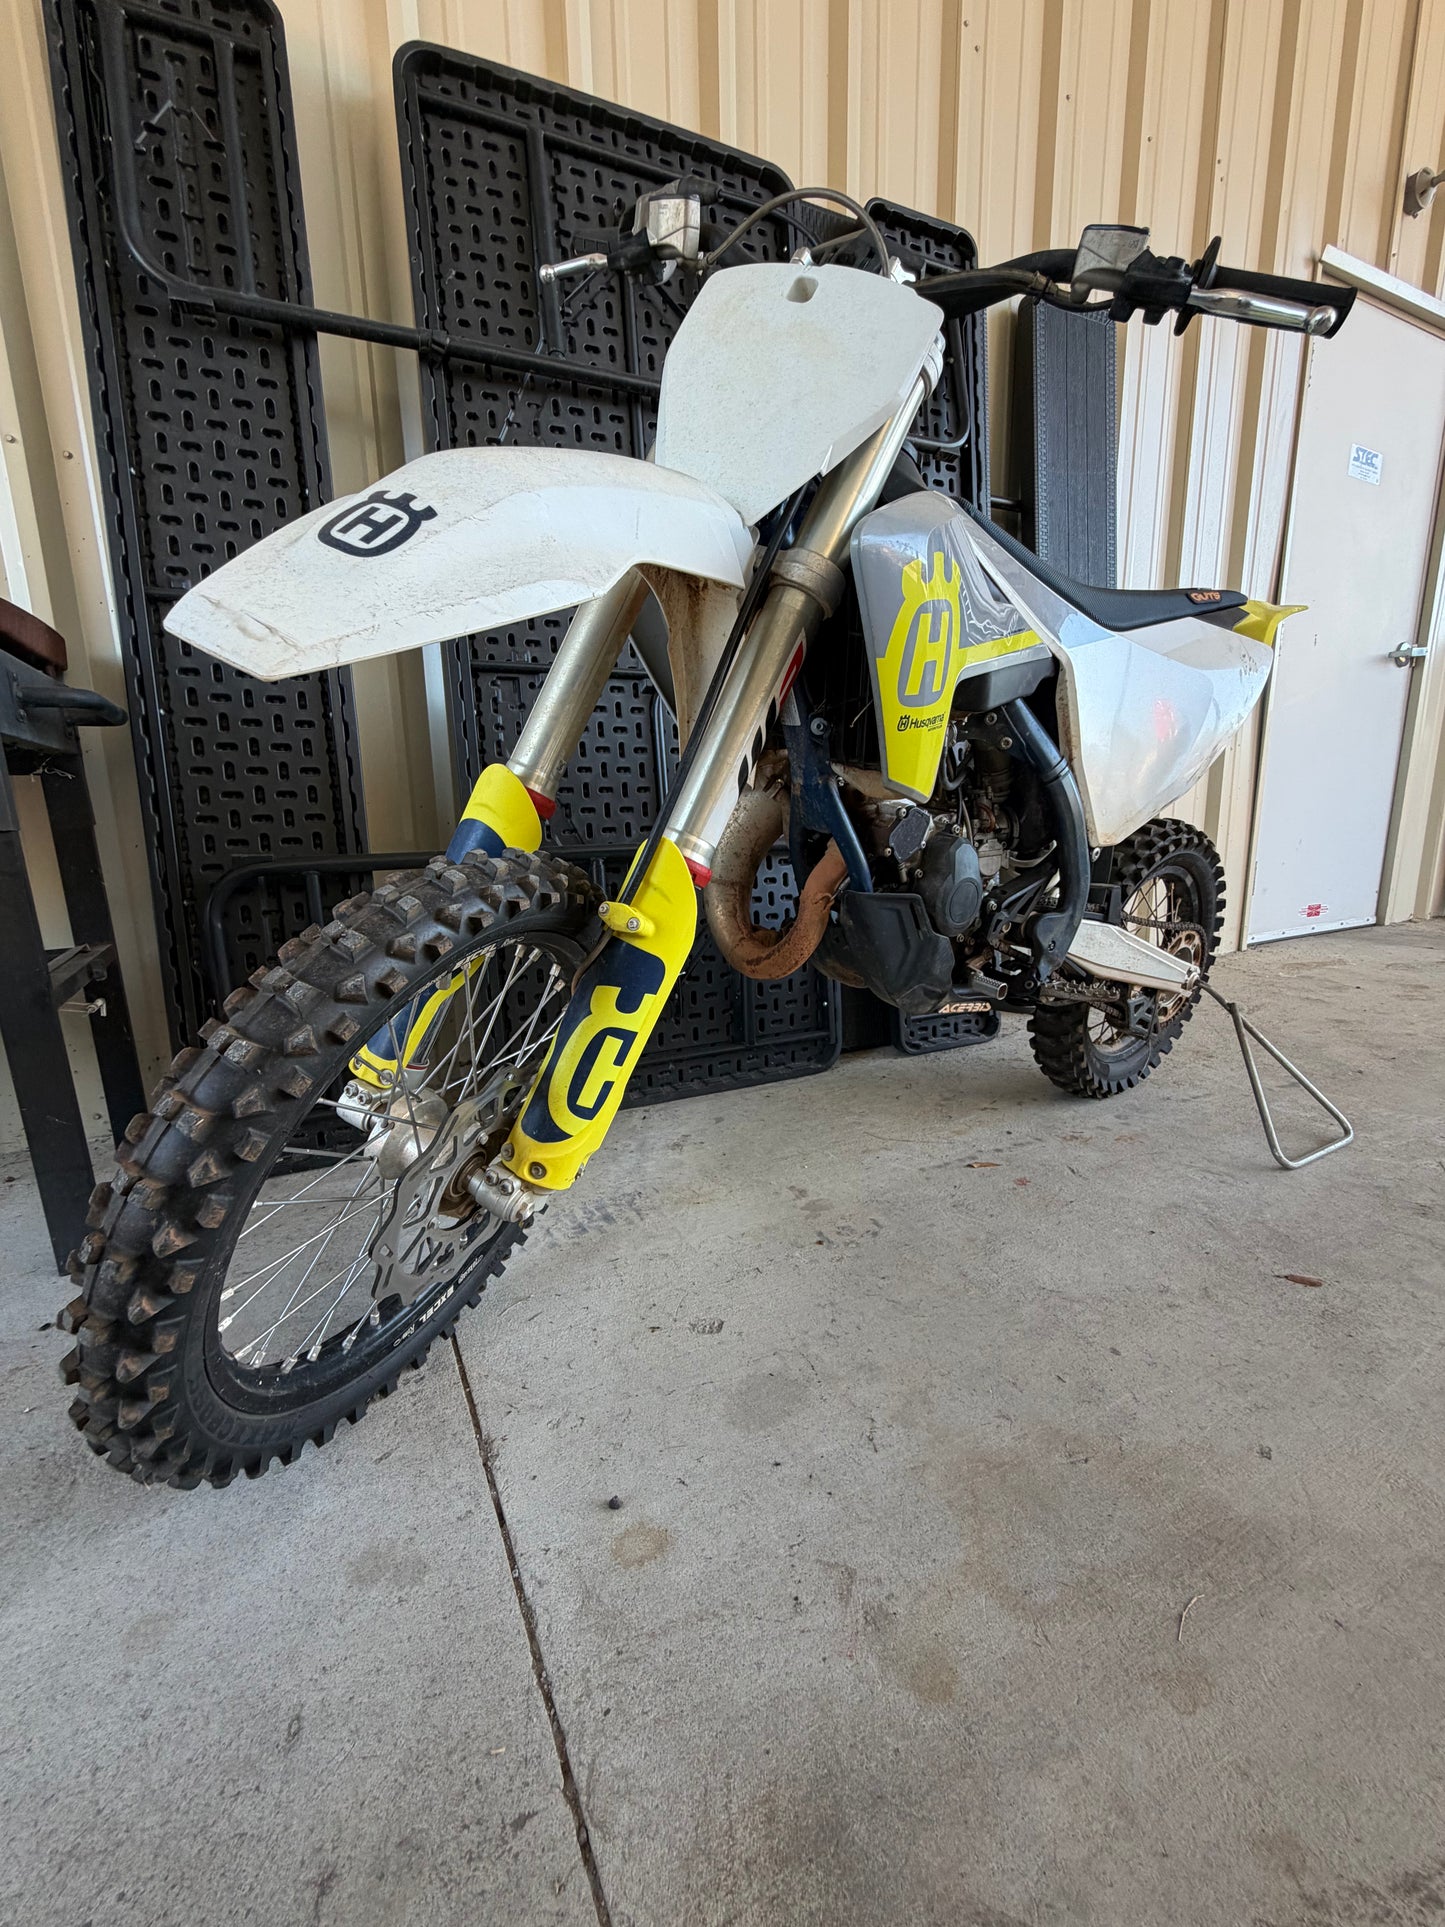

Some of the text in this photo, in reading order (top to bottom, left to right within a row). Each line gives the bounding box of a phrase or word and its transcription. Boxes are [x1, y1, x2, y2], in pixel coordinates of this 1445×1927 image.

[909, 713, 945, 729] Husqvarna
[938, 1002, 992, 1014] ACERBIS
[419, 1284, 454, 1323] EXCEL
